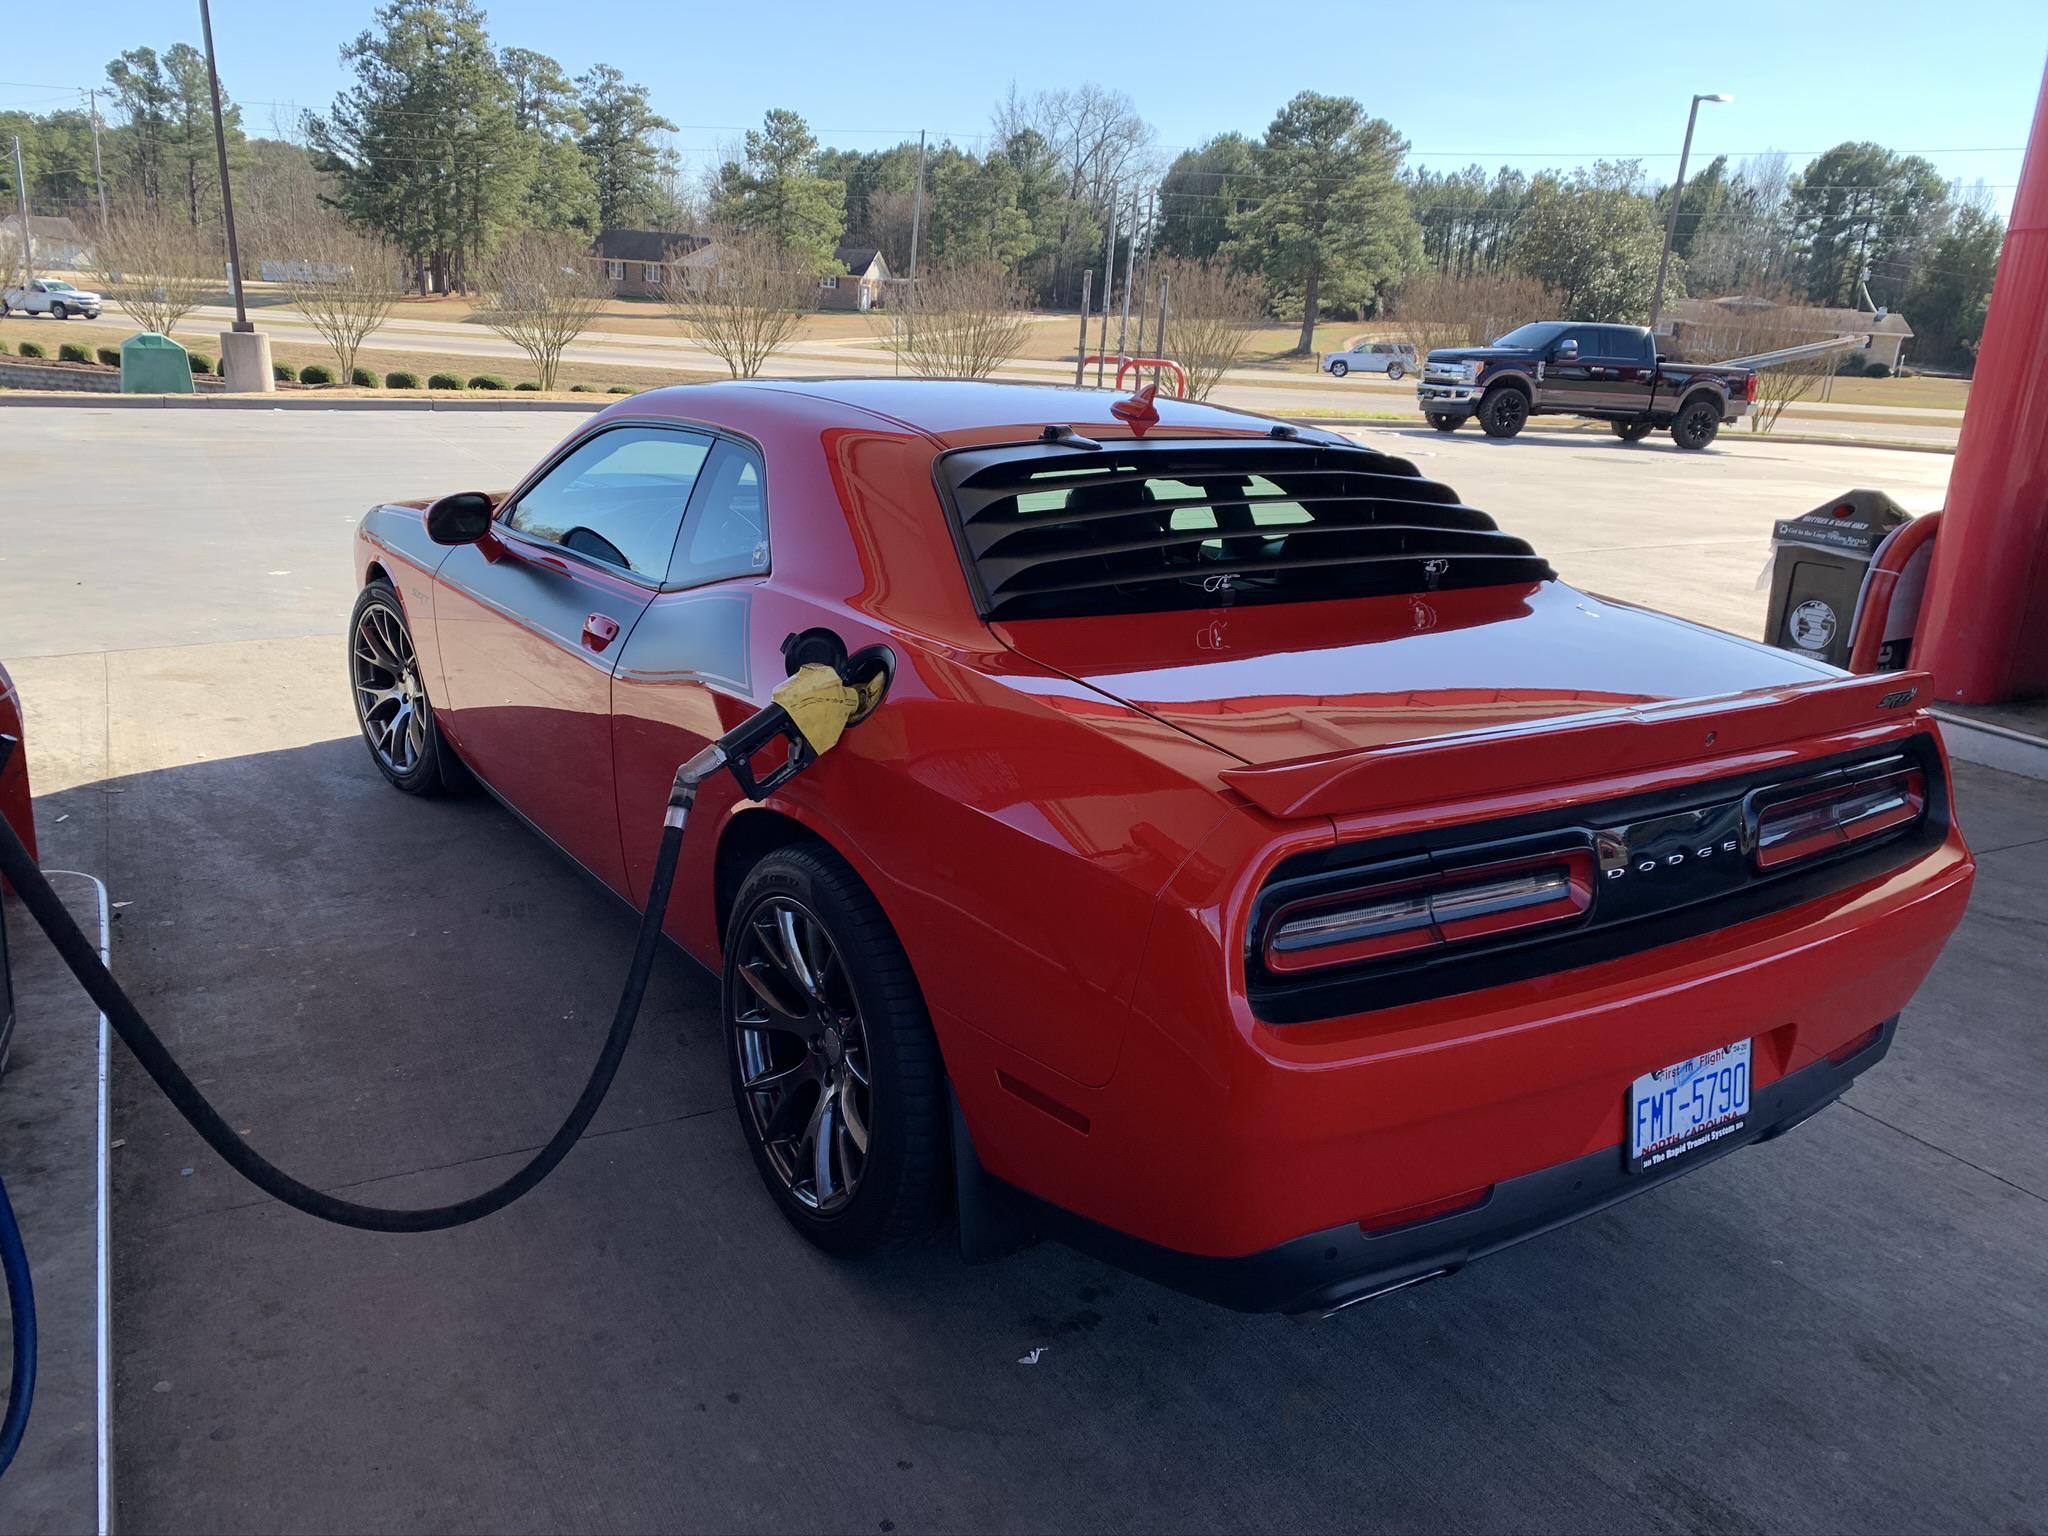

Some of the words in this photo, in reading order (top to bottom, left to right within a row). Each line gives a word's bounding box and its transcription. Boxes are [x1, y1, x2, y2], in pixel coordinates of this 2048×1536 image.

[1607, 840, 1737, 879] DODGE
[1699, 1051, 1725, 1067] Flight
[1637, 1062, 1745, 1148] FMT-5790
[1652, 1153, 1665, 1165] The
[1666, 1143, 1686, 1159] Rapid
[1686, 1132, 1711, 1150] Transit
[1711, 1125, 1735, 1141] System
